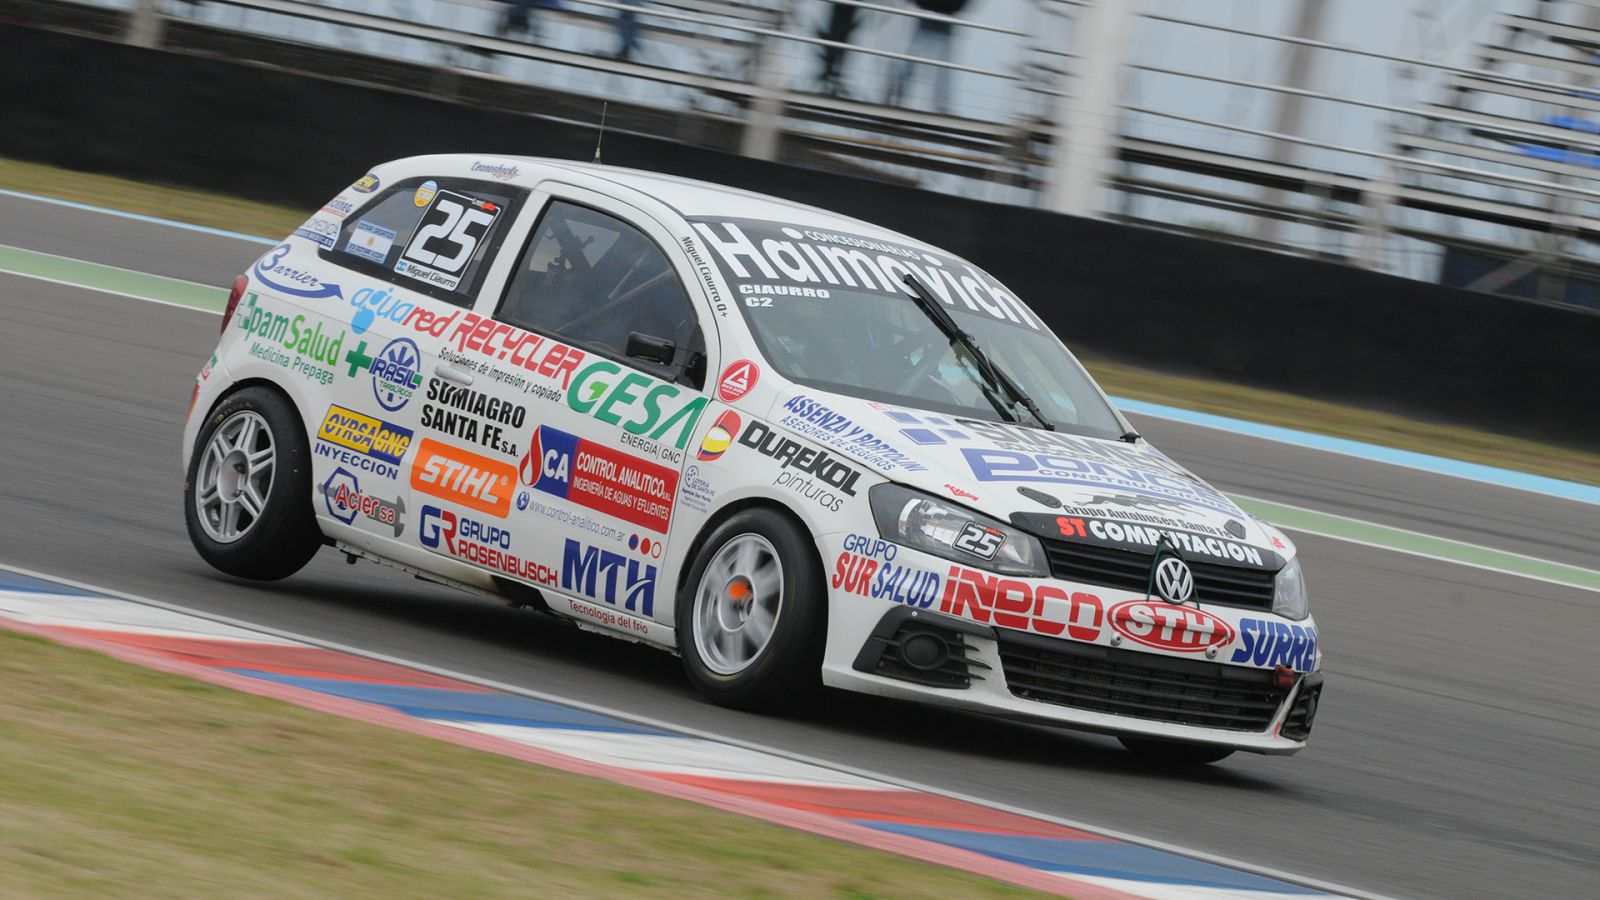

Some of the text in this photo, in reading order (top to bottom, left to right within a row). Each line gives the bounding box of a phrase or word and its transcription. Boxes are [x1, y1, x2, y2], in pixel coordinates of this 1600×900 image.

[405, 199, 494, 272] 25
[408, 264, 457, 288] Miguel Ciaurro
[682, 236, 706, 266] Miguel
[699, 266, 721, 302] Ciaurro
[692, 223, 1040, 330] Haimovich
[738, 284, 830, 299] CIAURRO
[745, 297, 774, 307] C2
[249, 342, 334, 385] Medicina Prepaga
[438, 347, 479, 370] Soluciones
[478, 362, 488, 375] de
[523, 382, 532, 393] y
[531, 384, 562, 402] copiado
[427, 378, 526, 428] SUMIAGRO
[567, 361, 710, 449] GESA
[783, 395, 853, 434] ASSENZA
[843, 425, 865, 438] Y
[421, 404, 478, 443] SANTA
[481, 424, 502, 450] FE
[620, 432, 681, 464] ENERGIA GNC
[779, 416, 896, 471] ASESORES DE SEGUROS
[314, 443, 398, 480] INYECCION
[419, 455, 498, 504] STIHL
[543, 448, 569, 485] CA
[576, 451, 617, 482] CONTROL
[617, 466, 665, 498] ANALITICO
[738, 419, 861, 497] DUREKOL
[335, 483, 395, 522] Acier sa
[604, 485, 614, 500] DE
[613, 489, 632, 508] AGUAS
[632, 496, 639, 509] Y
[637, 498, 669, 520] EFLUENTES
[772, 470, 844, 512] pinturas
[459, 517, 511, 550] GRUPO
[956, 526, 1002, 556] 25
[1056, 517, 1088, 537] ST
[1089, 519, 1263, 566] COMPUTACION
[1063, 504, 1231, 538] Grupo Autobuses Santa Fe
[458, 541, 558, 588] ROSENBUSCH
[843, 533, 897, 561] GRUPO
[562, 537, 657, 618] MTH
[617, 614, 631, 630] del
[1124, 604, 1215, 645] STH
